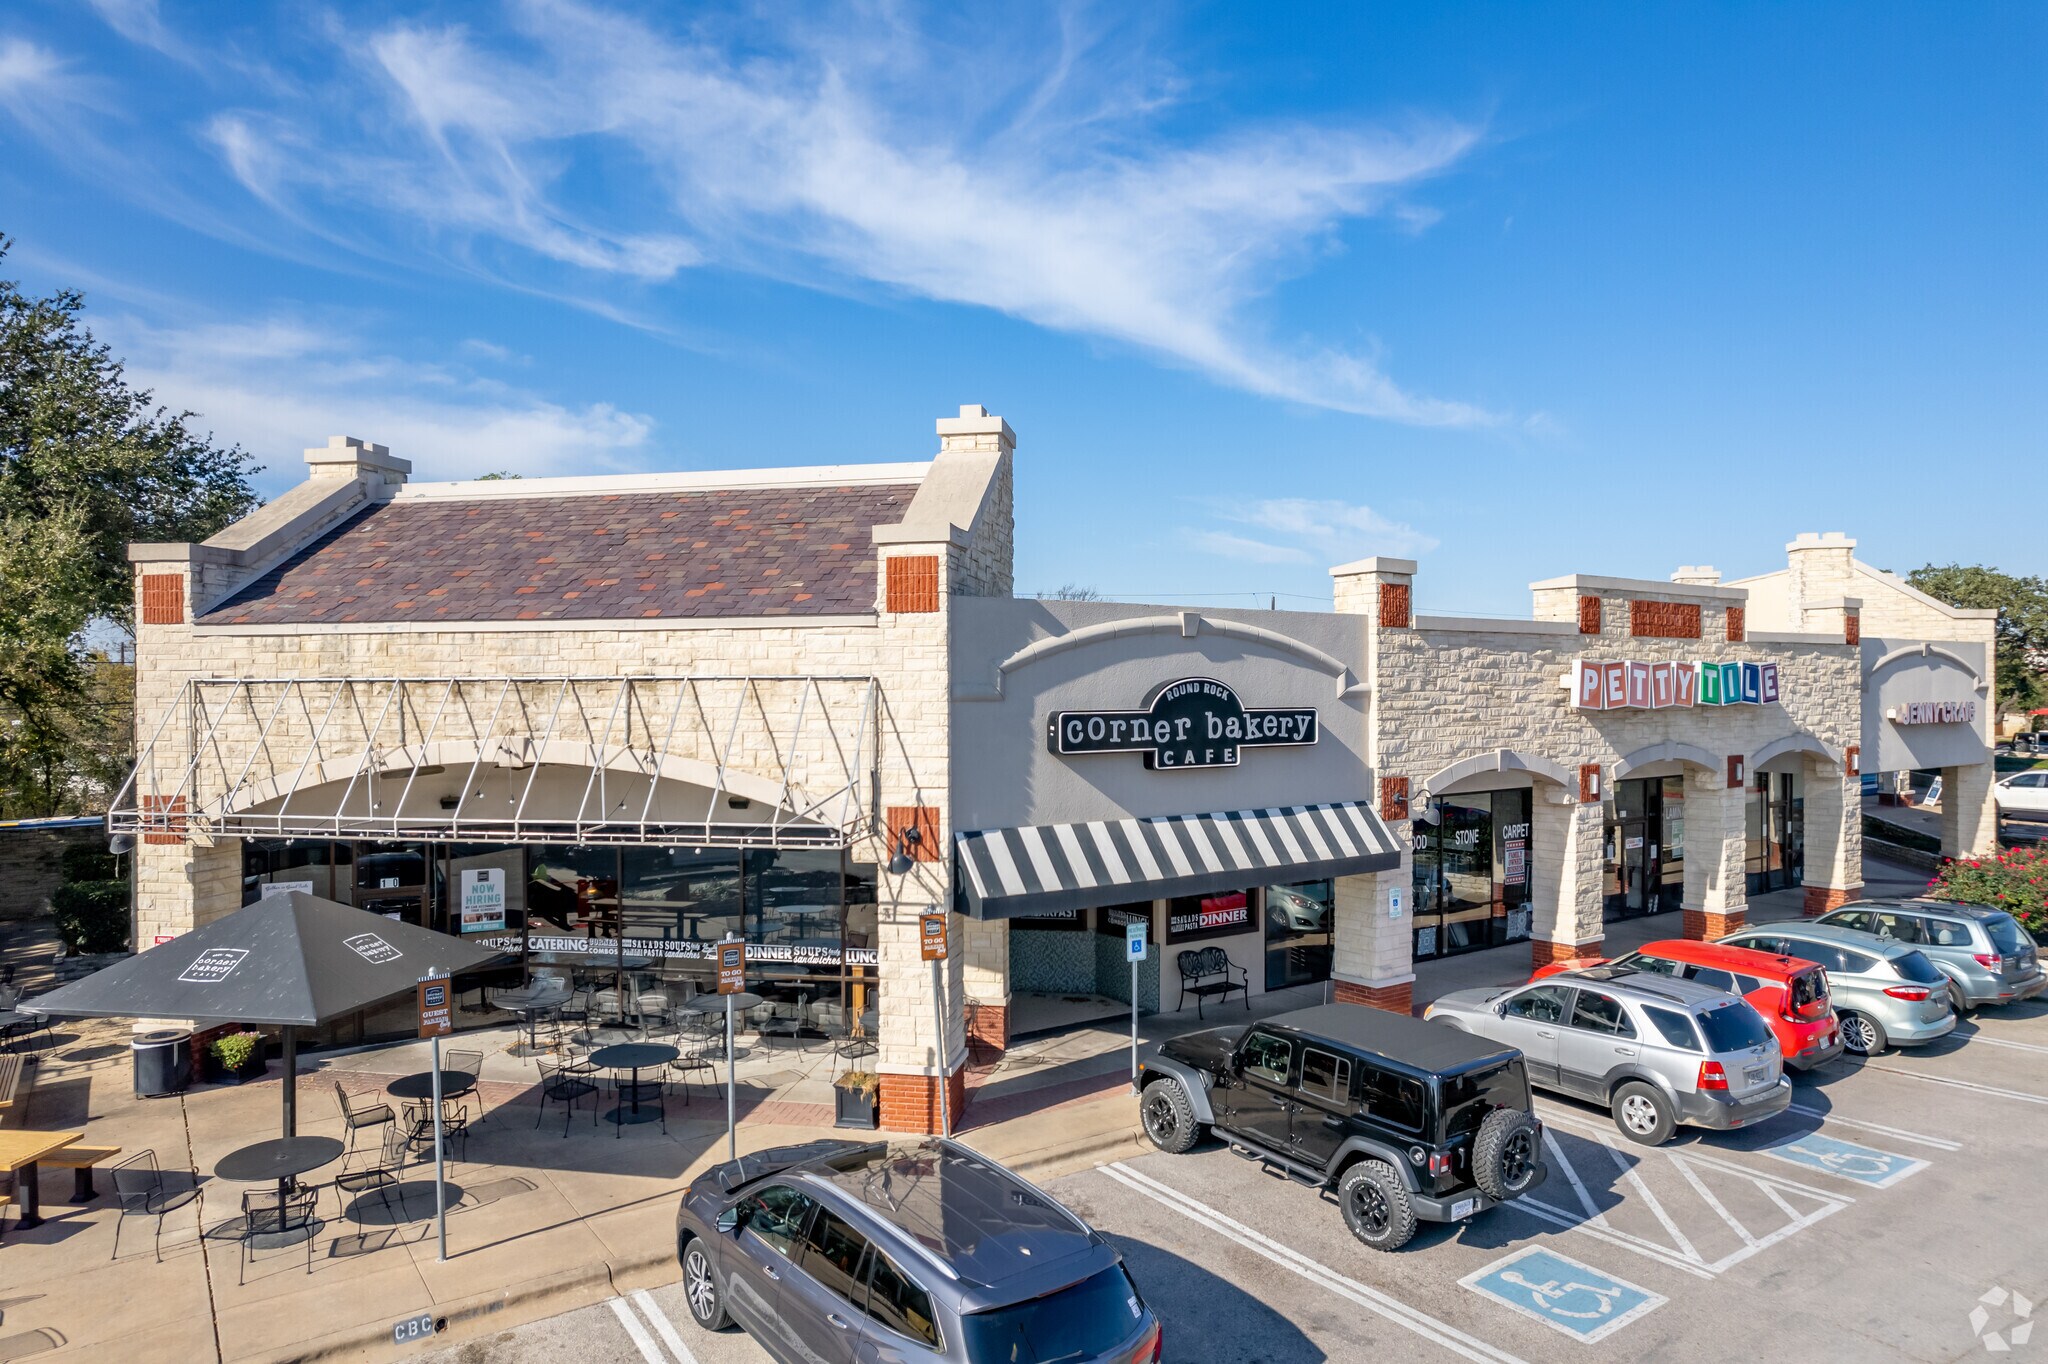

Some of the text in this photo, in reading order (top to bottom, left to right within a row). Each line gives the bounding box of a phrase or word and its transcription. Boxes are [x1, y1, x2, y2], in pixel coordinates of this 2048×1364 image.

[1166, 682, 1229, 701] ROUND ROCK
[1584, 668, 1776, 701] PETTY TILE
[1903, 701, 1976, 725] JENNY CRAIG
[1067, 711, 1312, 744] corner bakery
[1163, 748, 1233, 765] CAFE
[1455, 829, 1480, 845] STONE
[1502, 823, 1530, 839] CARPET
[1411, 834, 1428, 850] OOD
[472, 884, 495, 894] NOW
[465, 894, 501, 905] HIRING
[1177, 913, 1199, 924] SALADS
[1199, 909, 1248, 926] DINNER
[1184, 922, 1198, 930] PASTA
[528, 938, 588, 951] CATERING
[632, 939, 664, 949] SALADS
[664, 941, 691, 951] SOUPS
[588, 947, 618, 955] COMBOS
[643, 949, 664, 957] PASTA
[664, 950, 701, 959] sandwiches
[745, 946, 793, 960] DINNER
[793, 946, 828, 956] SOUPS
[793, 950, 879, 965] sandwiches LUNC
[191, 964, 231, 973] bakery
[197, 958, 237, 966] corner
[422, 1008, 449, 1018] GUEST
[395, 1317, 431, 1339] CBC
